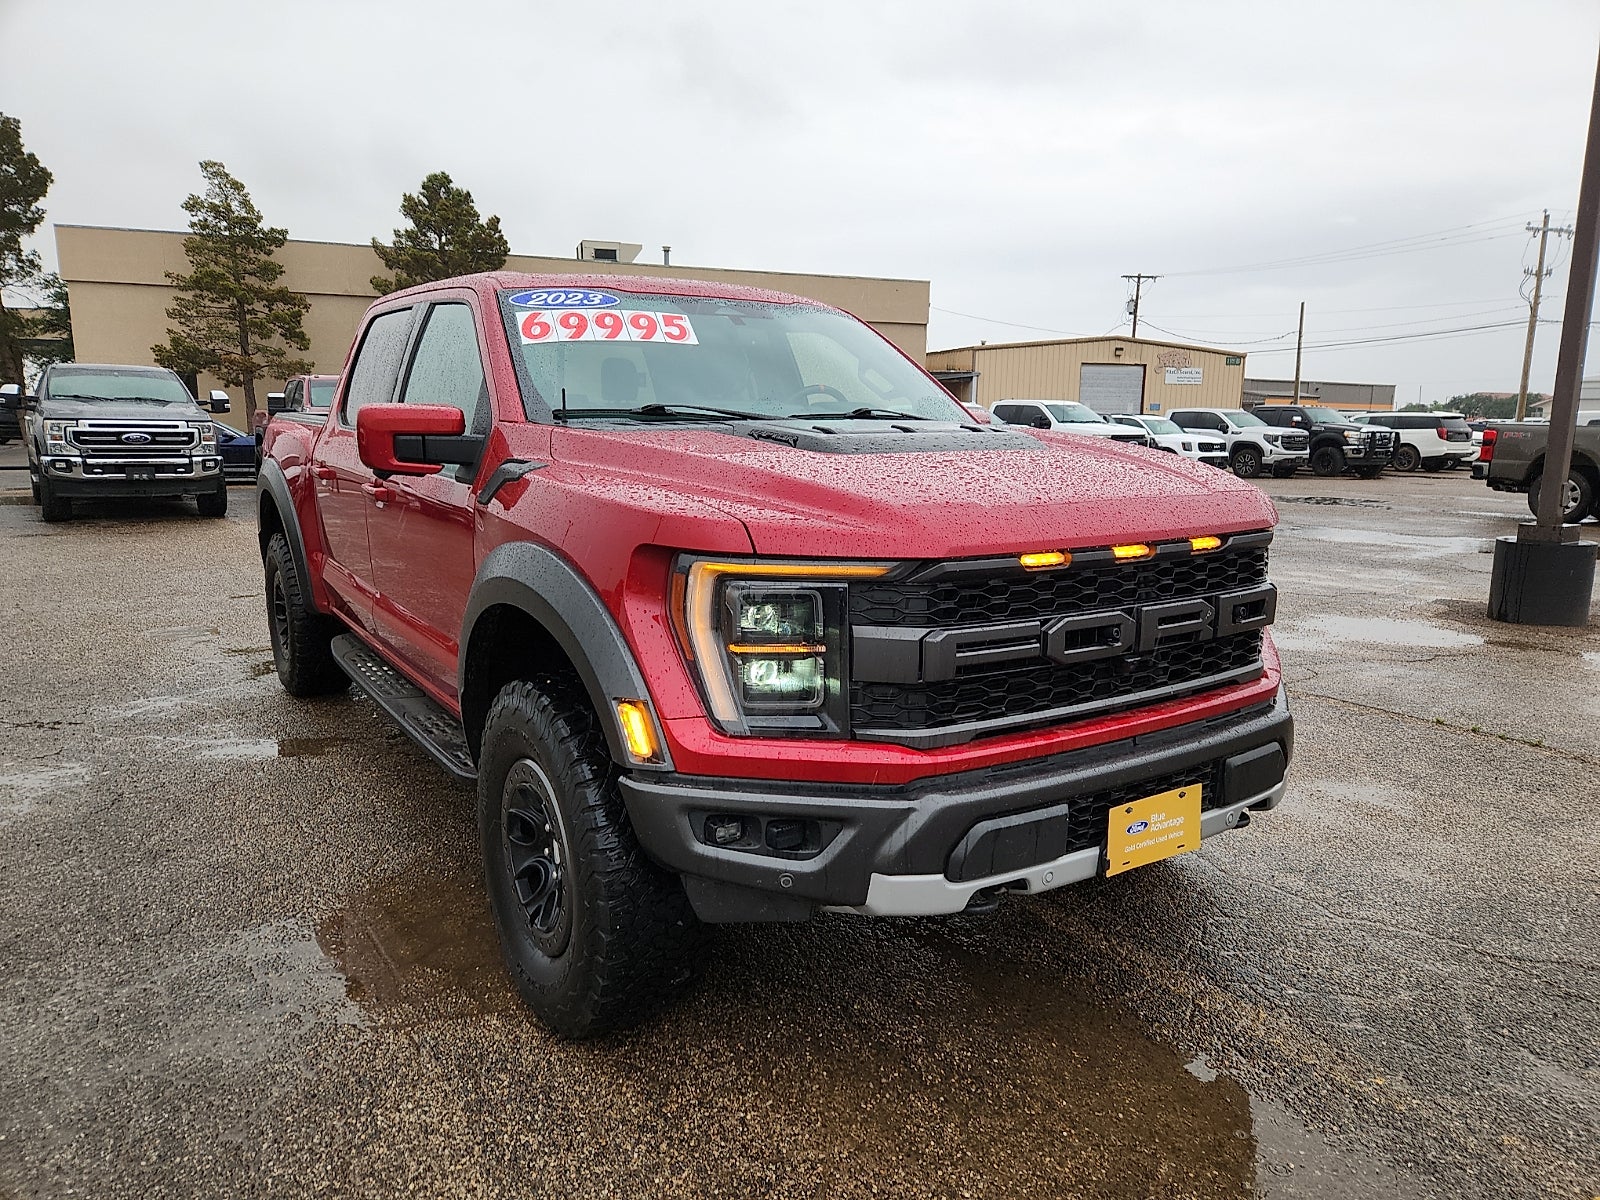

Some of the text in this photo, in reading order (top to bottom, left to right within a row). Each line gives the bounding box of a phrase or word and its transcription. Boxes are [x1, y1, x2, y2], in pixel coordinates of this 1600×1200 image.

[527, 292, 603, 305] 2023
[521, 311, 690, 341] 69995
[922, 582, 1277, 683] FORD
[1151, 813, 1165, 823] Blue
[1151, 817, 1184, 832] Advantage
[1130, 822, 1145, 833] Ford
[1125, 830, 1184, 853] Gold Certified Used Vehicle
